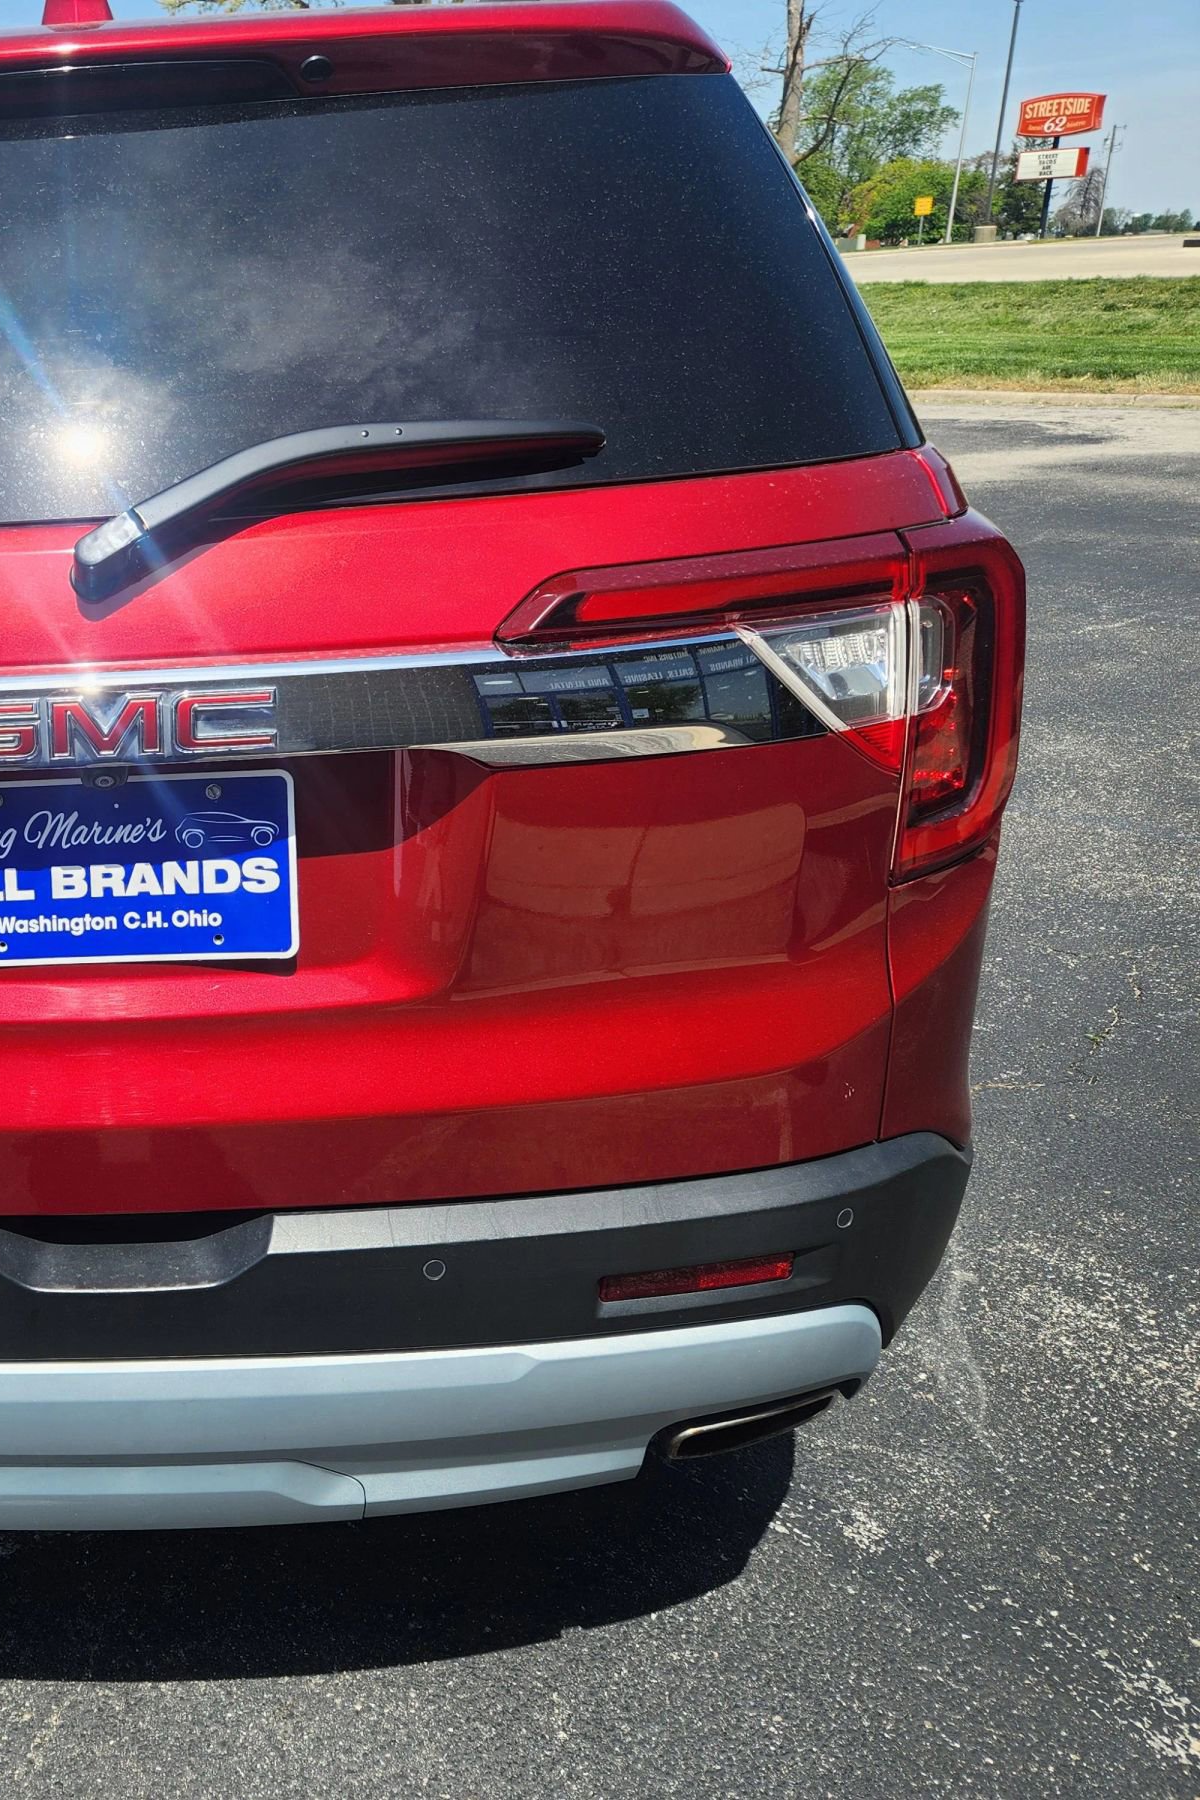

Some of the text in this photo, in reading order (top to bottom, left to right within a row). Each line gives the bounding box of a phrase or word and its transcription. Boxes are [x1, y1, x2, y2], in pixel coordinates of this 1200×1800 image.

[1025, 98, 1092, 119] STREETSIDE
[1043, 116, 1067, 133] 62
[22, 808, 167, 850] Marine's
[51, 857, 281, 899] BRANDS
[123, 911, 168, 929] C.H.
[172, 909, 222, 928] Ohio
